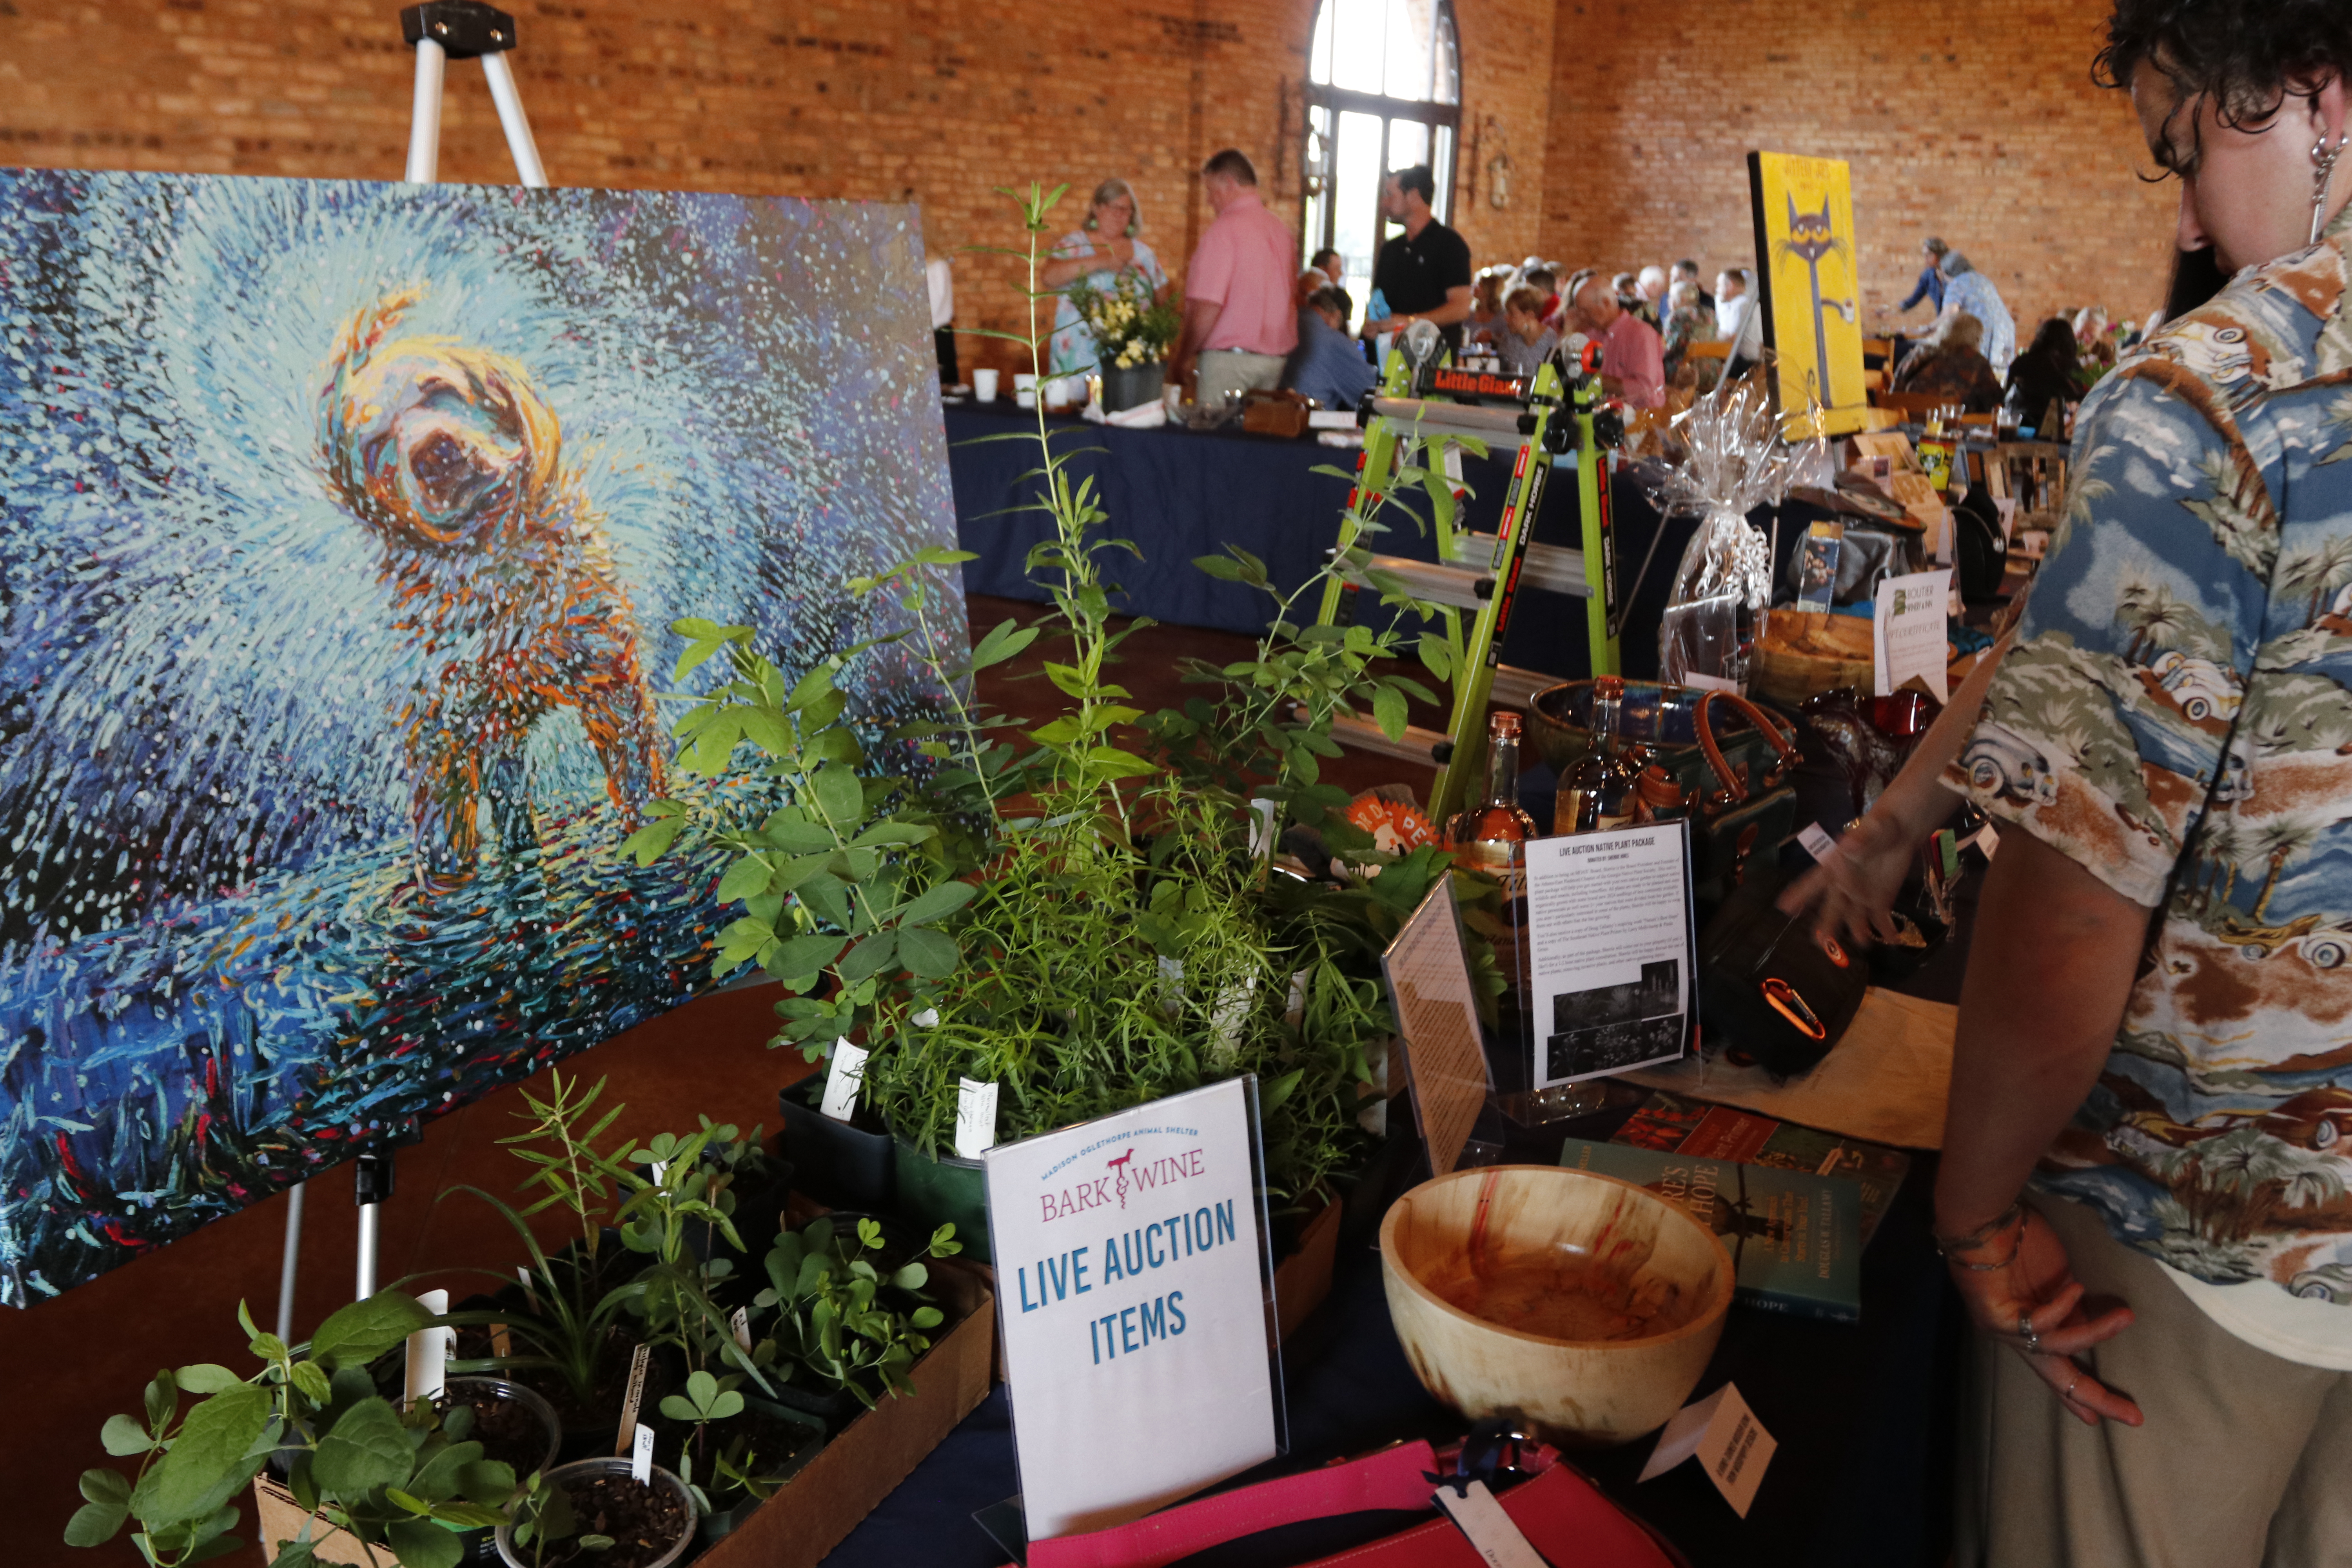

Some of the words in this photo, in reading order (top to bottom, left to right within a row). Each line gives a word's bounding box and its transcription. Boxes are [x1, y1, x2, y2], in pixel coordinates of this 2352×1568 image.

[1434, 369, 1477, 392] Little
[1519, 510, 1535, 546] DARK
[1530, 466, 1544, 510] HORSE
[1560, 847, 1571, 857] LIVE
[1572, 844, 1595, 855] AUCTION
[1596, 842, 1614, 852] NATIVE
[1615, 839, 1630, 850] PLANT
[1632, 836, 1655, 848] PACKAGE
[1041, 1153, 1079, 1181] MADISON
[1080, 1131, 1131, 1156] OGLETHORPE
[1133, 1127, 1163, 1137] ANIMAL
[1165, 1127, 1199, 1136] SHELTER
[1040, 1176, 1110, 1223] BARK
[1131, 1148, 1205, 1193] WINE
[1661, 1166, 1689, 1201] RE'S
[1689, 1165, 1719, 1216] HOPE
[1820, 1188, 1833, 1227] TALLAMY
[1018, 1247, 1091, 1313] LIVE
[1104, 1198, 1236, 1285] AUCTION
[1818, 1238, 1831, 1279] DOUGLAS
[1091, 1290, 1187, 1365] ITEMS
